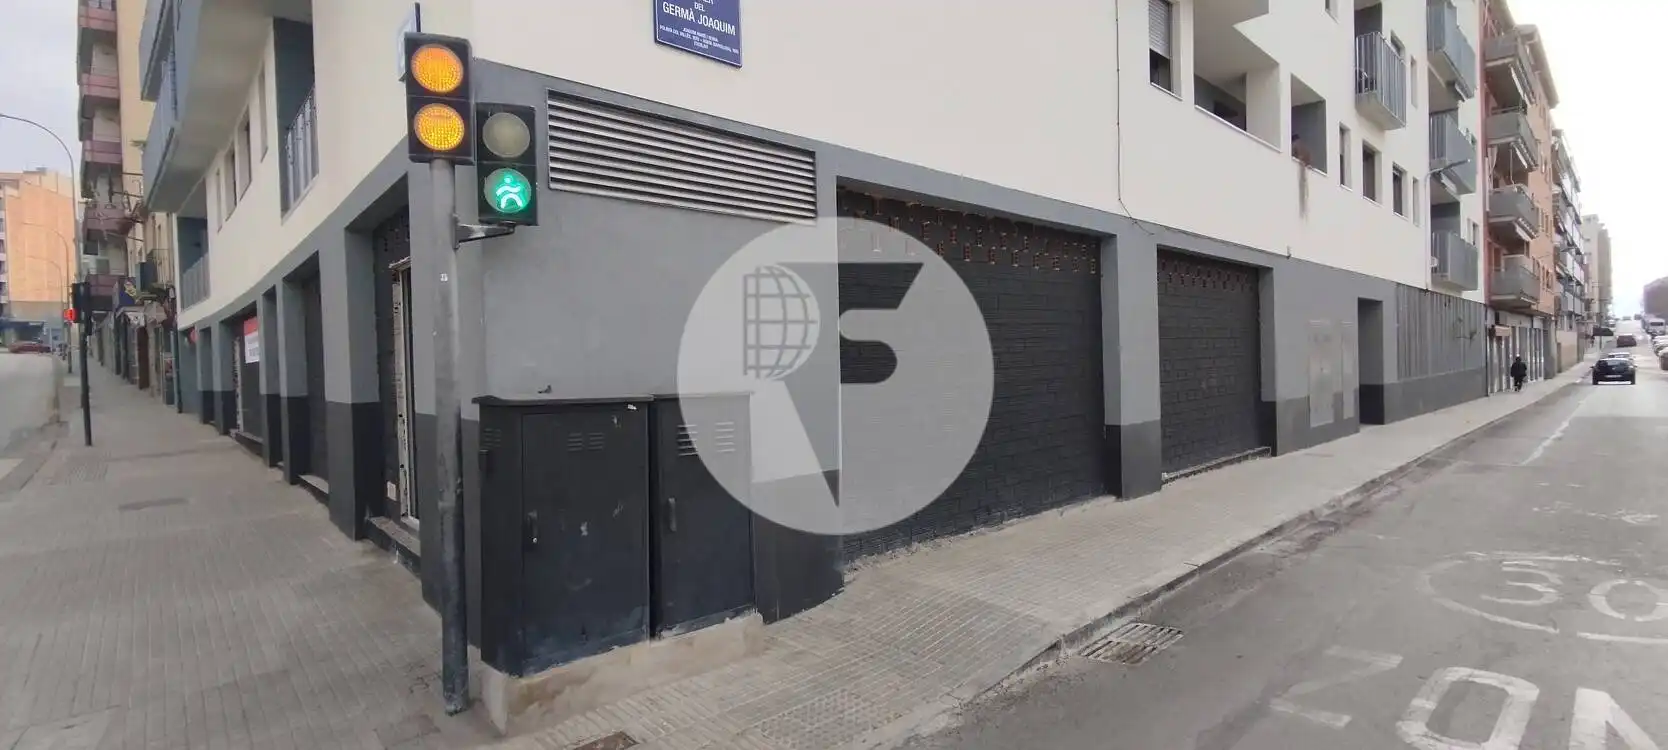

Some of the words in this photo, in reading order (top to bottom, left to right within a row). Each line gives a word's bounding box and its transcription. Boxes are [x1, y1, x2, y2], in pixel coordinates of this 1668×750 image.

[694, 2, 705, 12] DEL
[662, 1, 695, 23] GERMÀ
[697, 14, 736, 36] JOAQUIM
